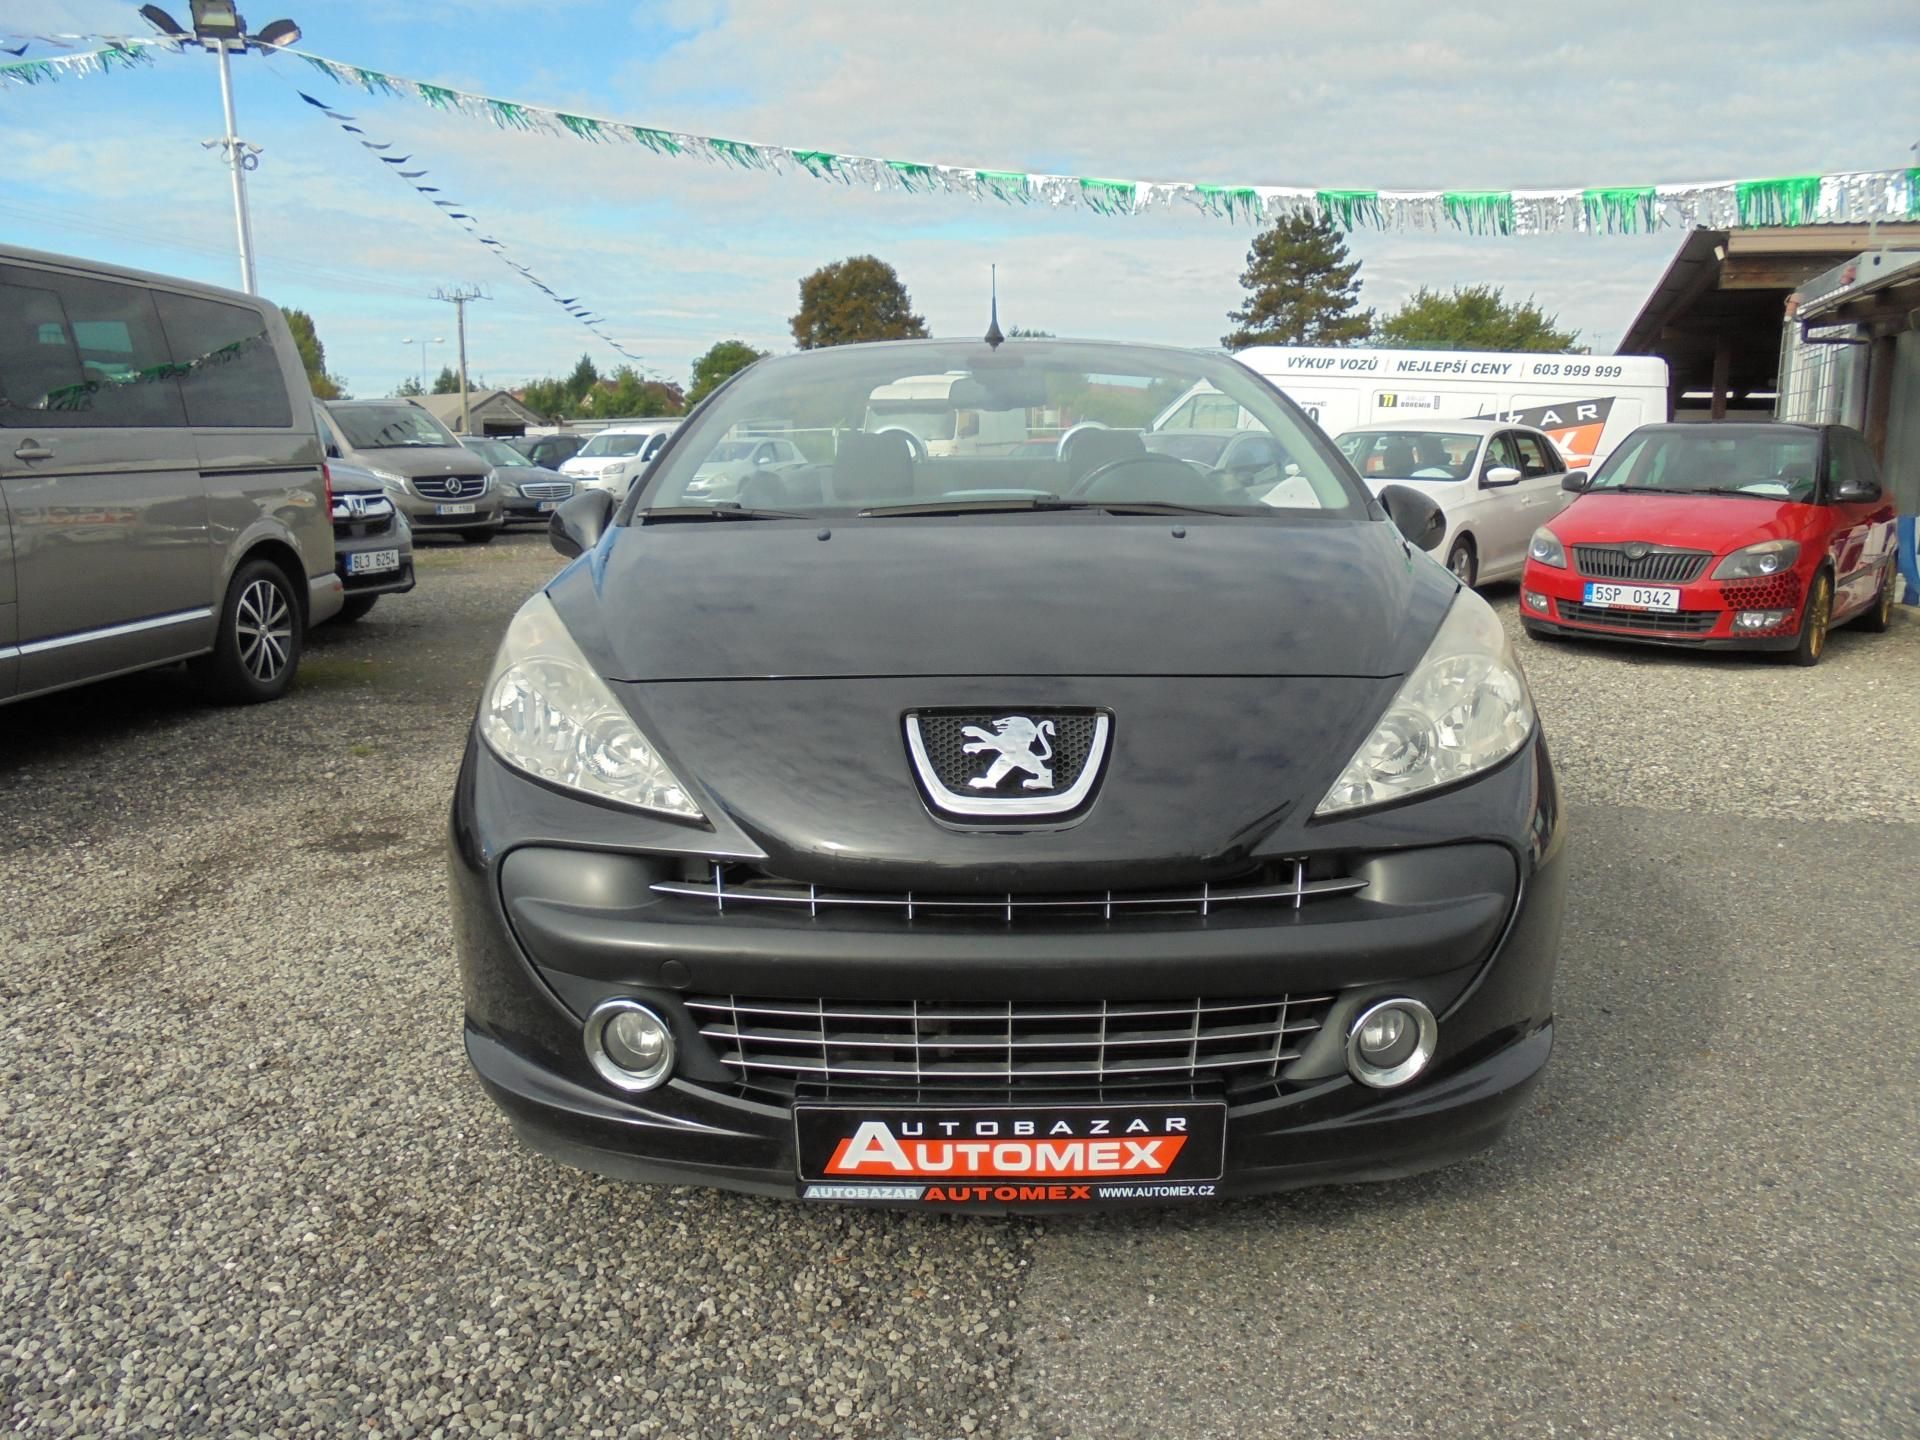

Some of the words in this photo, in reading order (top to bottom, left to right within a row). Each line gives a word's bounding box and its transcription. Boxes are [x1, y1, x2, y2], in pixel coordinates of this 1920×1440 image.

[1288, 354, 1335, 368] VÝKUP
[1340, 356, 1378, 370] VOZŮ
[1397, 359, 1468, 373] NEJLEPŠÍ
[1471, 362, 1512, 375] CENY
[1533, 363, 1559, 375] 603
[1563, 364, 1590, 377] 999
[1595, 366, 1622, 377] 999
[354, 554, 370, 568] 6L3
[376, 552, 395, 566] 6254
[1596, 586, 1621, 601] 5SP
[1633, 589, 1671, 606] 0342
[838, 1121, 1163, 1171] AUTOMEX
[808, 1187, 917, 1199] AUTOBAZAR
[925, 1186, 1090, 1200] AUTOMEX
[1099, 1185, 1215, 1198] WWW.AUTOMEX.CZ
